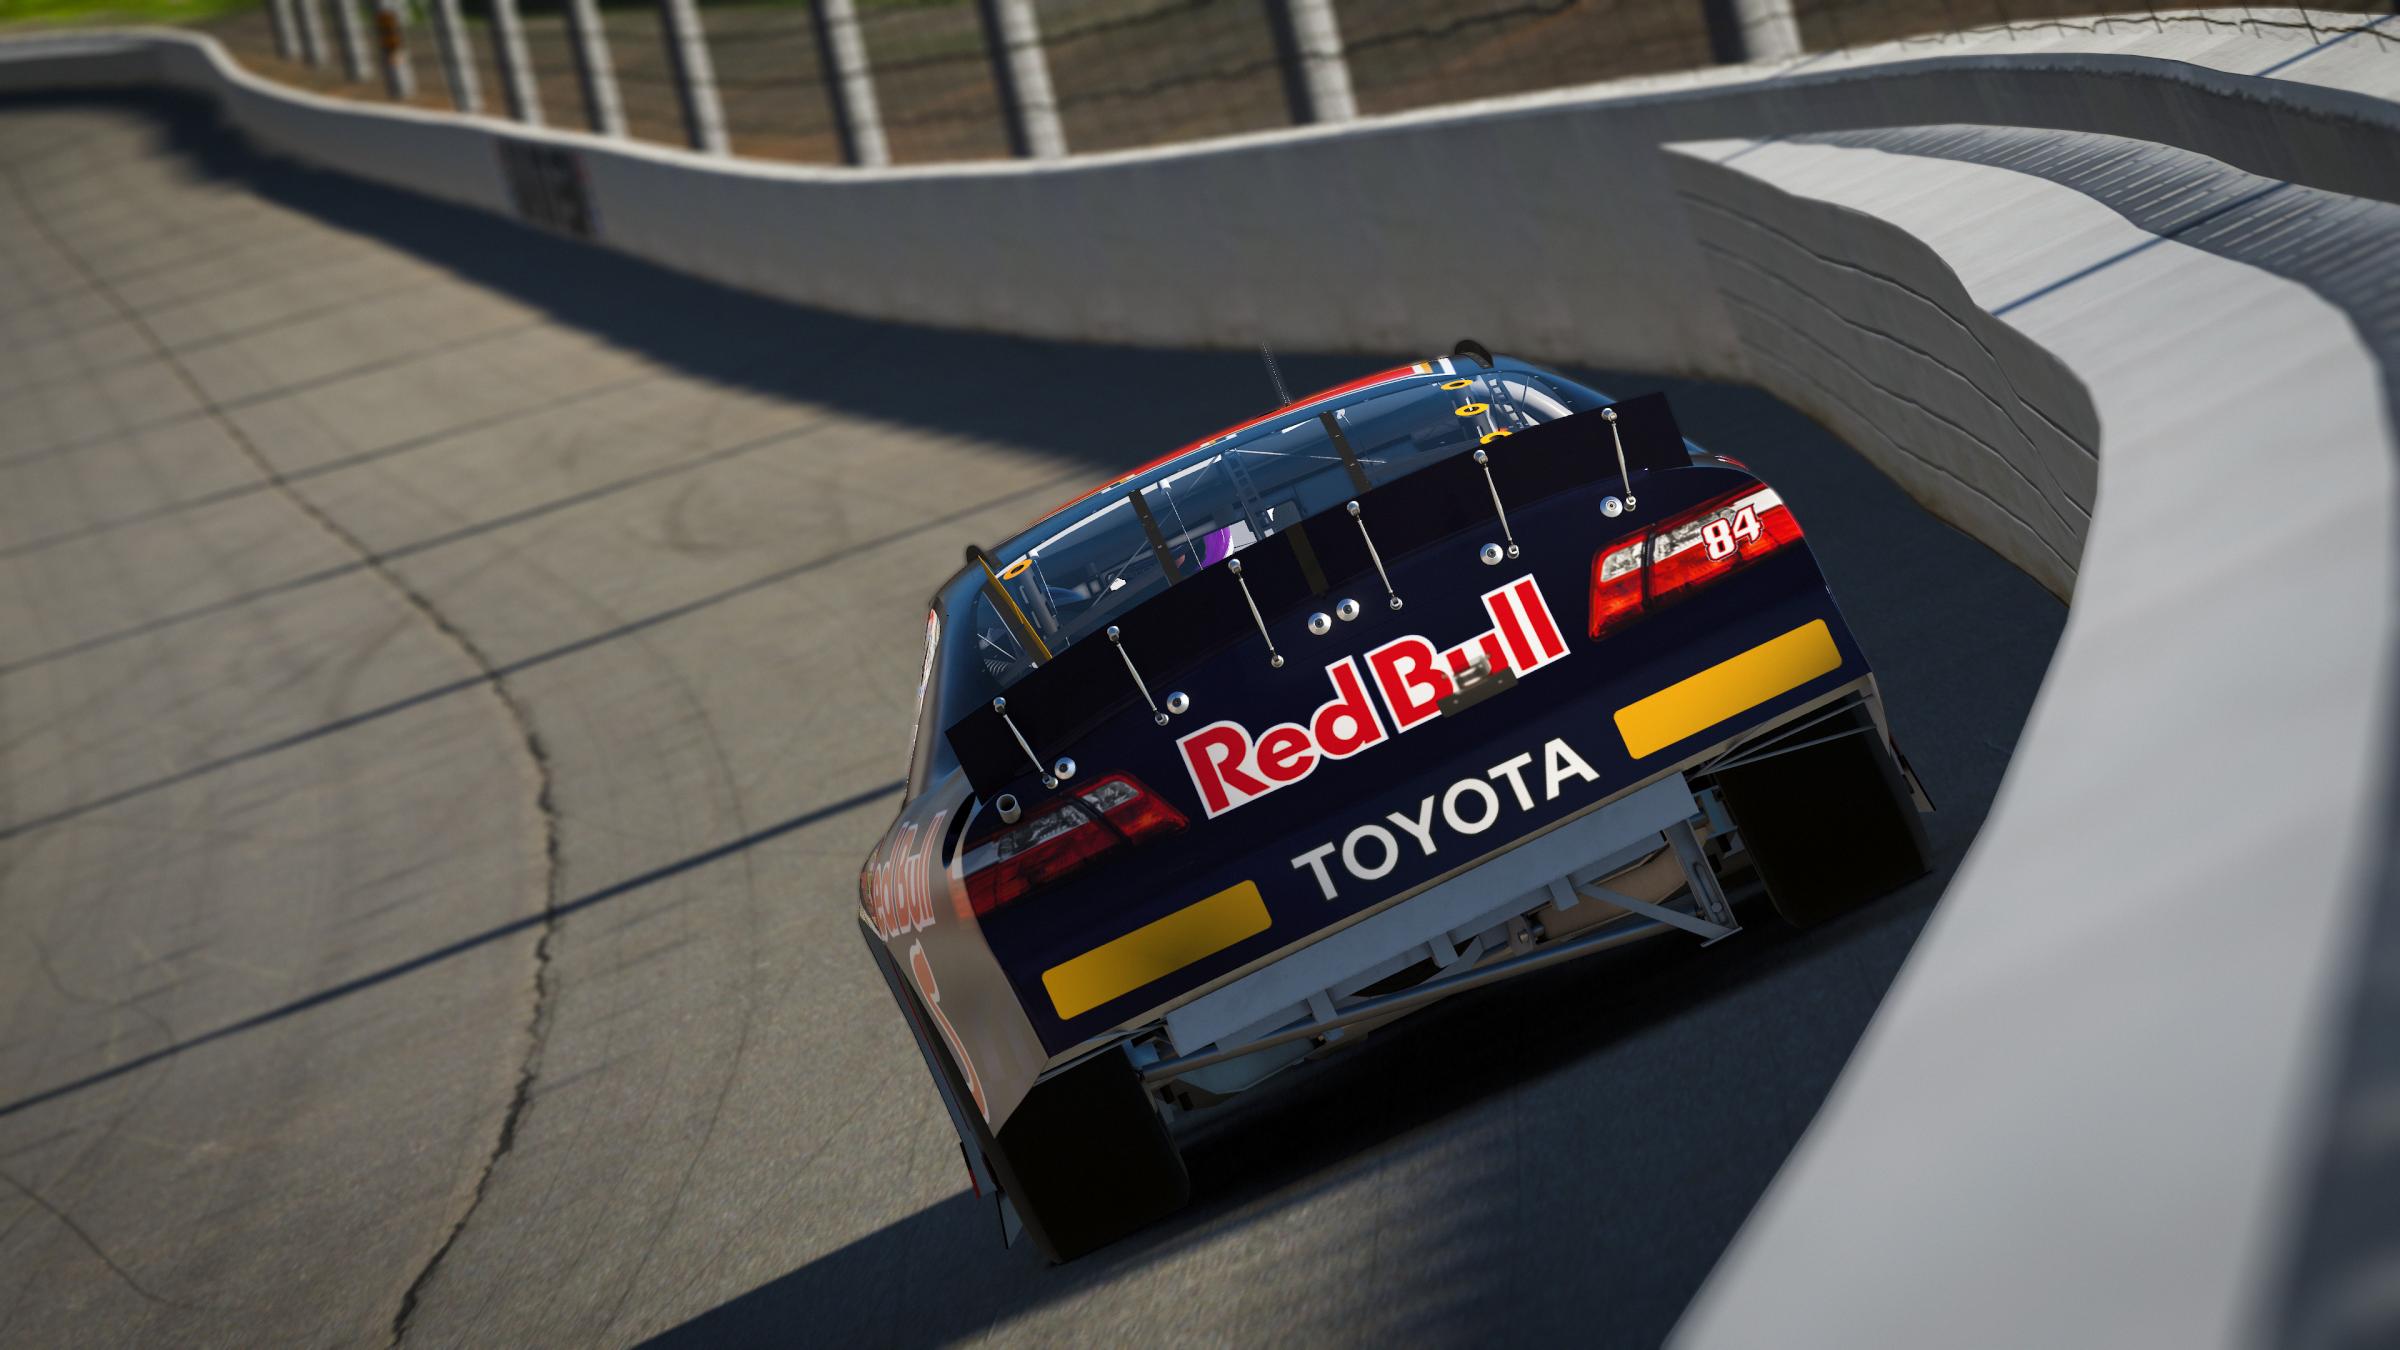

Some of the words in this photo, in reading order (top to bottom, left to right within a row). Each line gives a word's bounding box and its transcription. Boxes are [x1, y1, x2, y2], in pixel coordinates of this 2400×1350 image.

[1701, 504, 1763, 562] 84
[1176, 655, 1389, 820] Red
[1363, 573, 1571, 733] Bull
[869, 821, 909, 942] ed
[894, 810, 948, 934] Bull
[1291, 738, 1600, 901] TOYOTA
